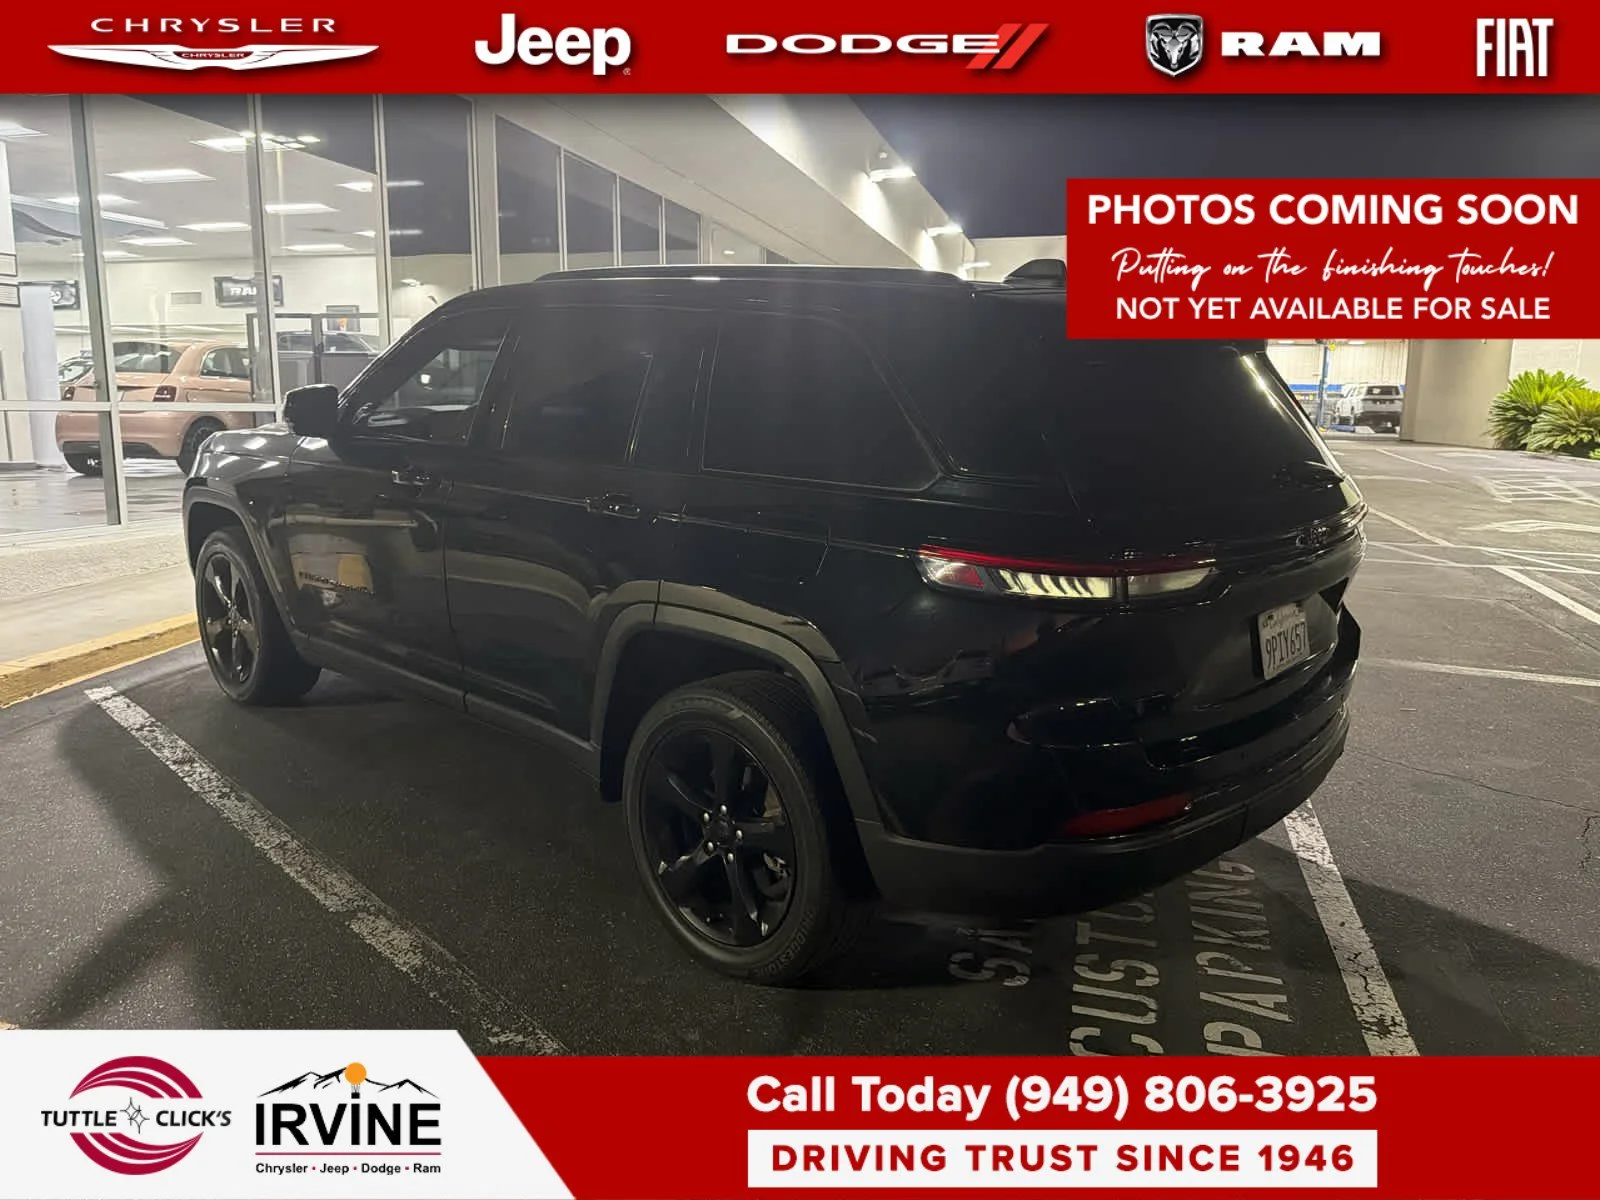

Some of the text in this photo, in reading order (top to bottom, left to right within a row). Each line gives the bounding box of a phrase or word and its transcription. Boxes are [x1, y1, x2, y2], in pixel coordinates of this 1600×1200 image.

[1265, 622, 1306, 671] 9PIY657
[947, 919, 1033, 987] SA
[1184, 860, 1296, 1056] PARKING
